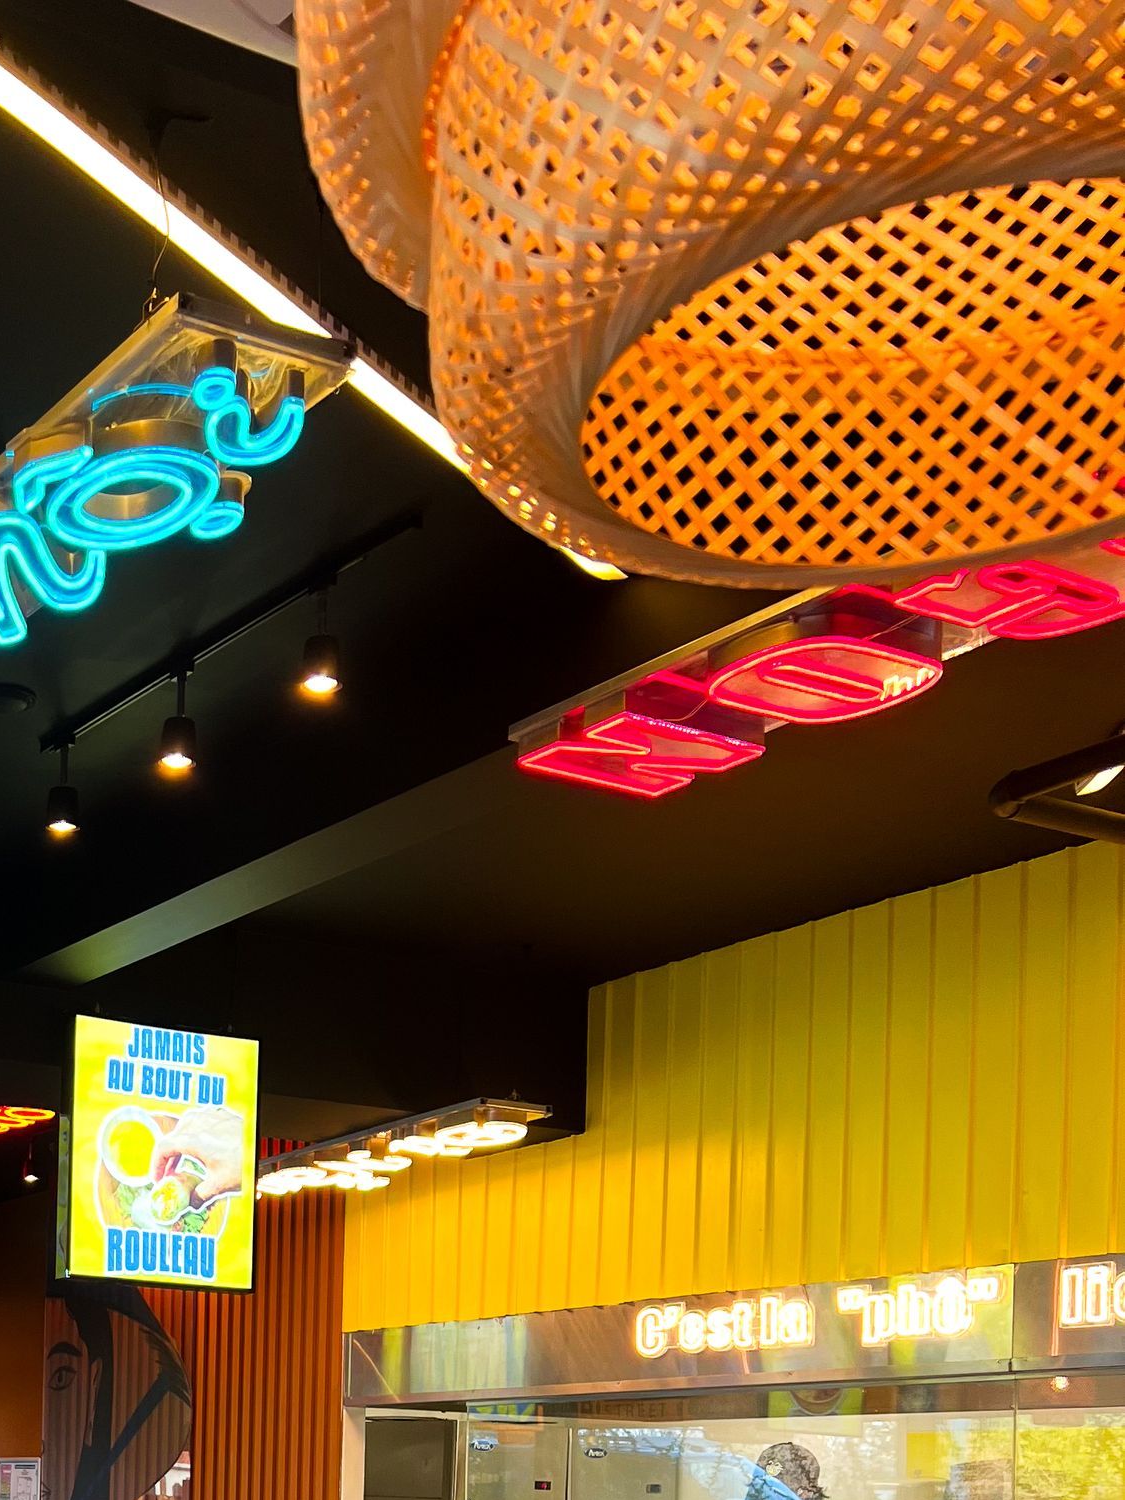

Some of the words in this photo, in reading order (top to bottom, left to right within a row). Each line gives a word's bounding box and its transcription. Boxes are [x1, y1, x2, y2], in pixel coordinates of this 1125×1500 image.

[128, 1028, 206, 1065] JAMAIS
[108, 1060, 135, 1092] AU
[141, 1067, 193, 1101] BOUT
[198, 1074, 225, 1105] DU
[107, 1228, 216, 1279] ROULEAU
[758, 1292, 815, 1348] la
